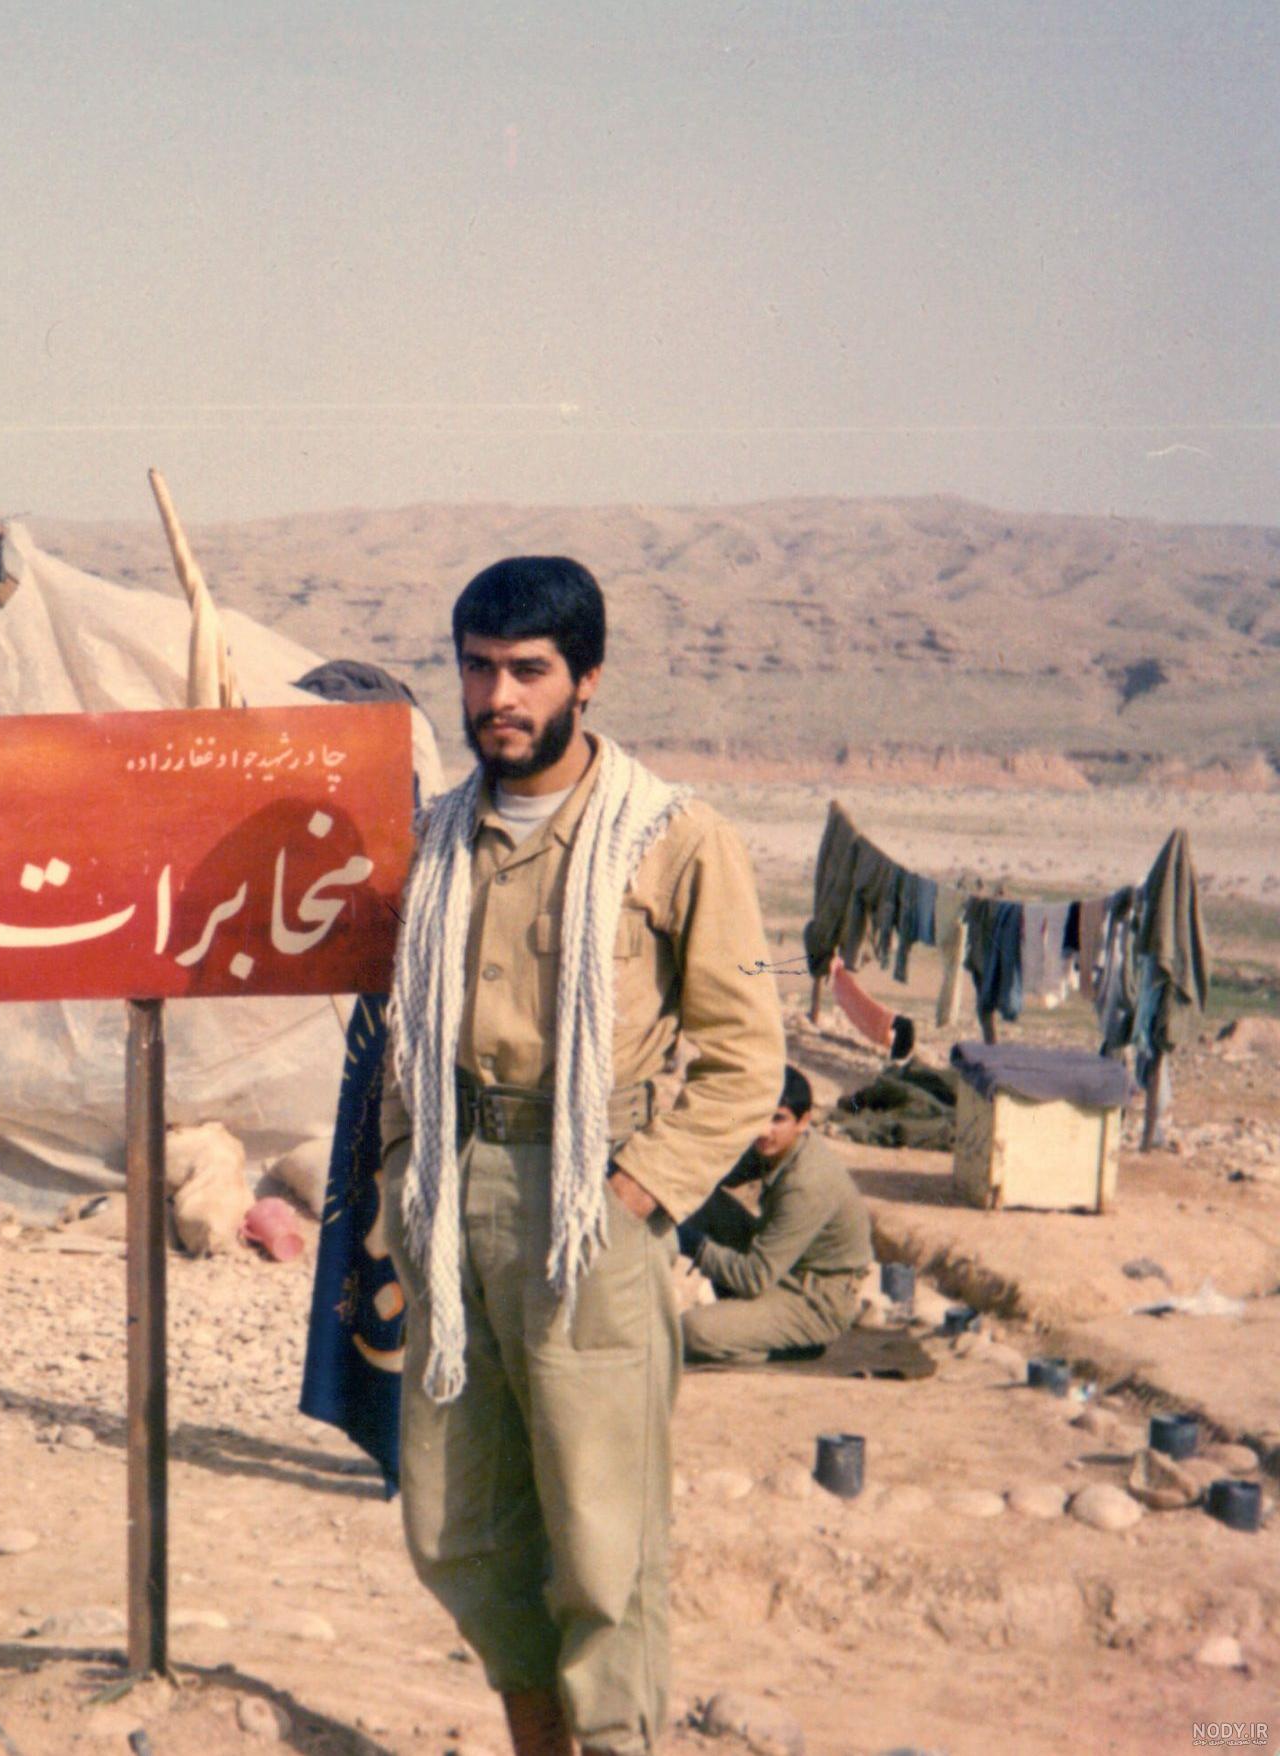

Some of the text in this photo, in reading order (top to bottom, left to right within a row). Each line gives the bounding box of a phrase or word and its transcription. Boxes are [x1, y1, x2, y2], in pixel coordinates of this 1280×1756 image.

[217, 749, 257, 779] جواد
[257, 731, 293, 781] شهید
[288, 744, 347, 793] چادر
